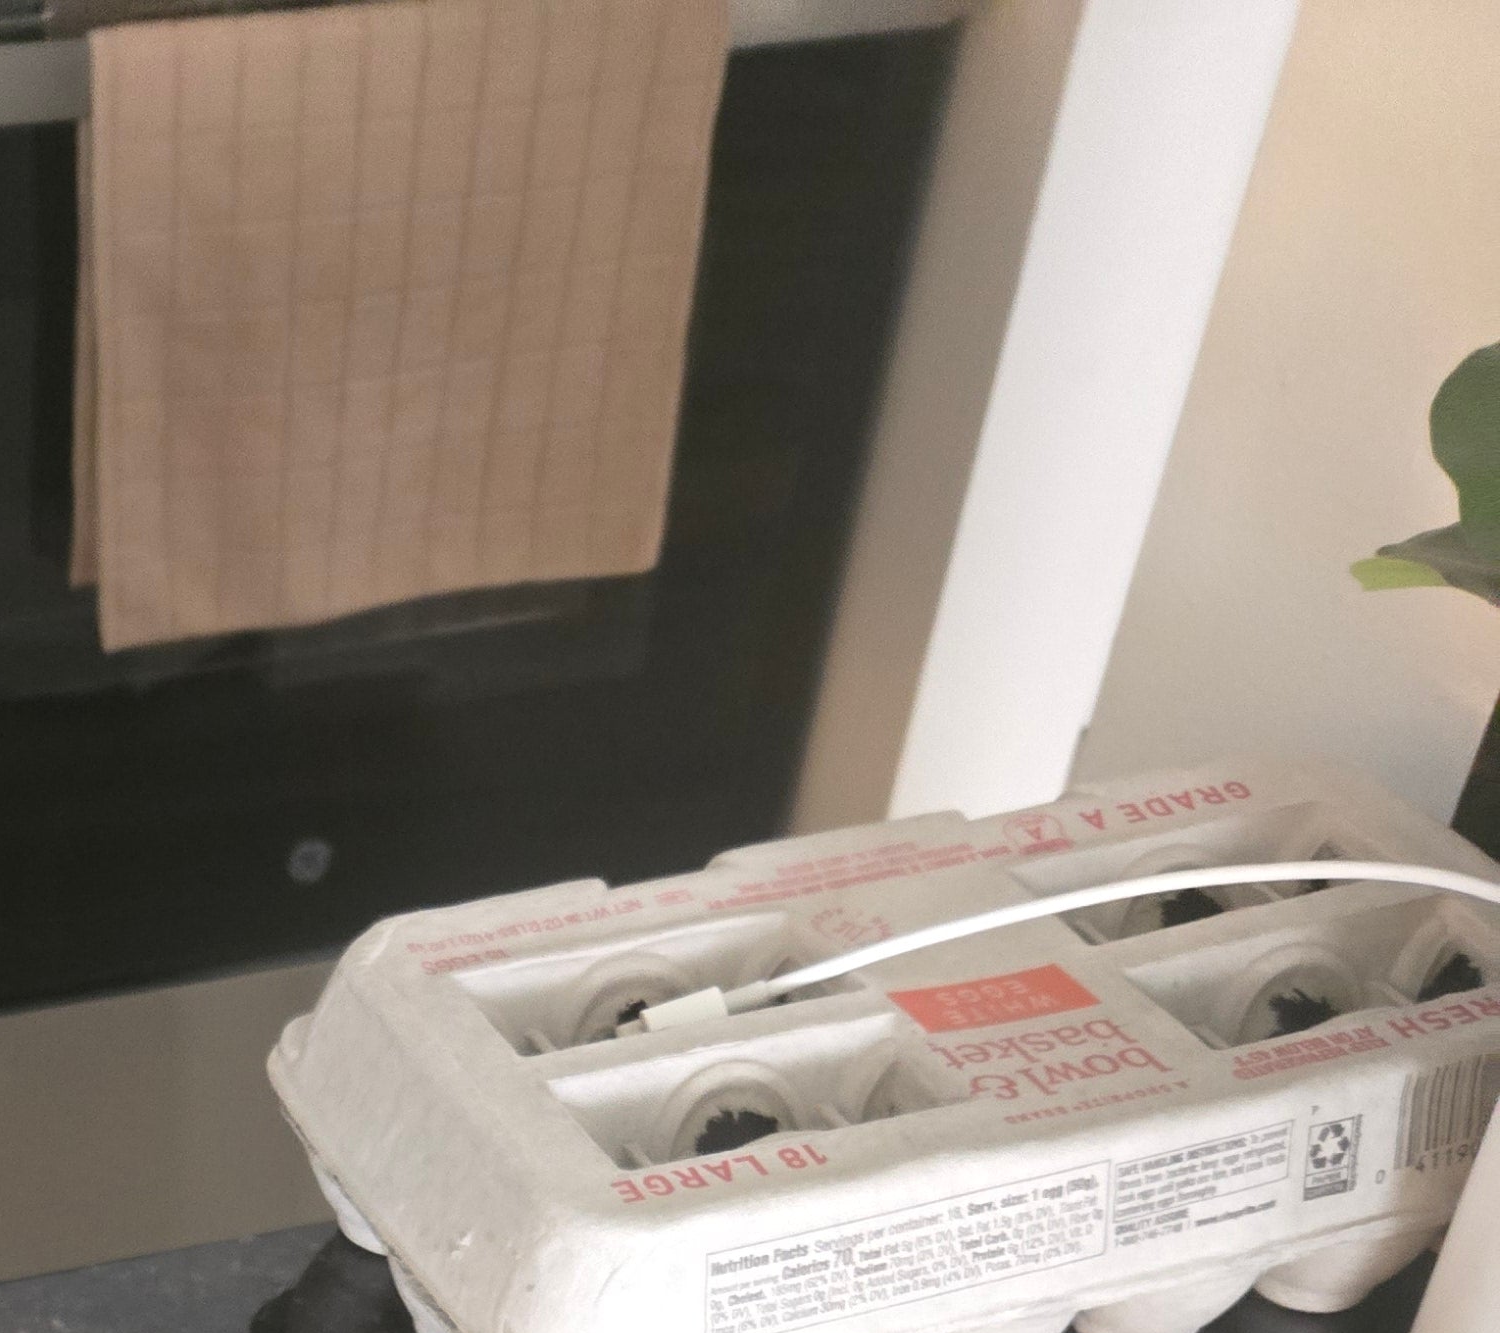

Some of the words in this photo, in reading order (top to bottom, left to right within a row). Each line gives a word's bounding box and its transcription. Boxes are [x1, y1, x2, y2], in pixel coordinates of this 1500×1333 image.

[1116, 781, 1252, 824] GRADE
[1079, 809, 1105, 830] A
[420, 953, 483, 977] EGGS
[935, 979, 1030, 1005] EGGS
[946, 993, 1054, 1025] WHITE
[926, 1018, 1138, 1070] basket
[1015, 1047, 1173, 1096] bowl
[776, 1144, 829, 1170] 18
[610, 1154, 769, 1204] LARGE
[711, 1253, 769, 1278] Nutrition
[774, 1242, 809, 1263] Facts
[814, 1232, 864, 1255] Servings
[868, 1229, 884, 1244] per
[782, 1259, 830, 1282] Calories
